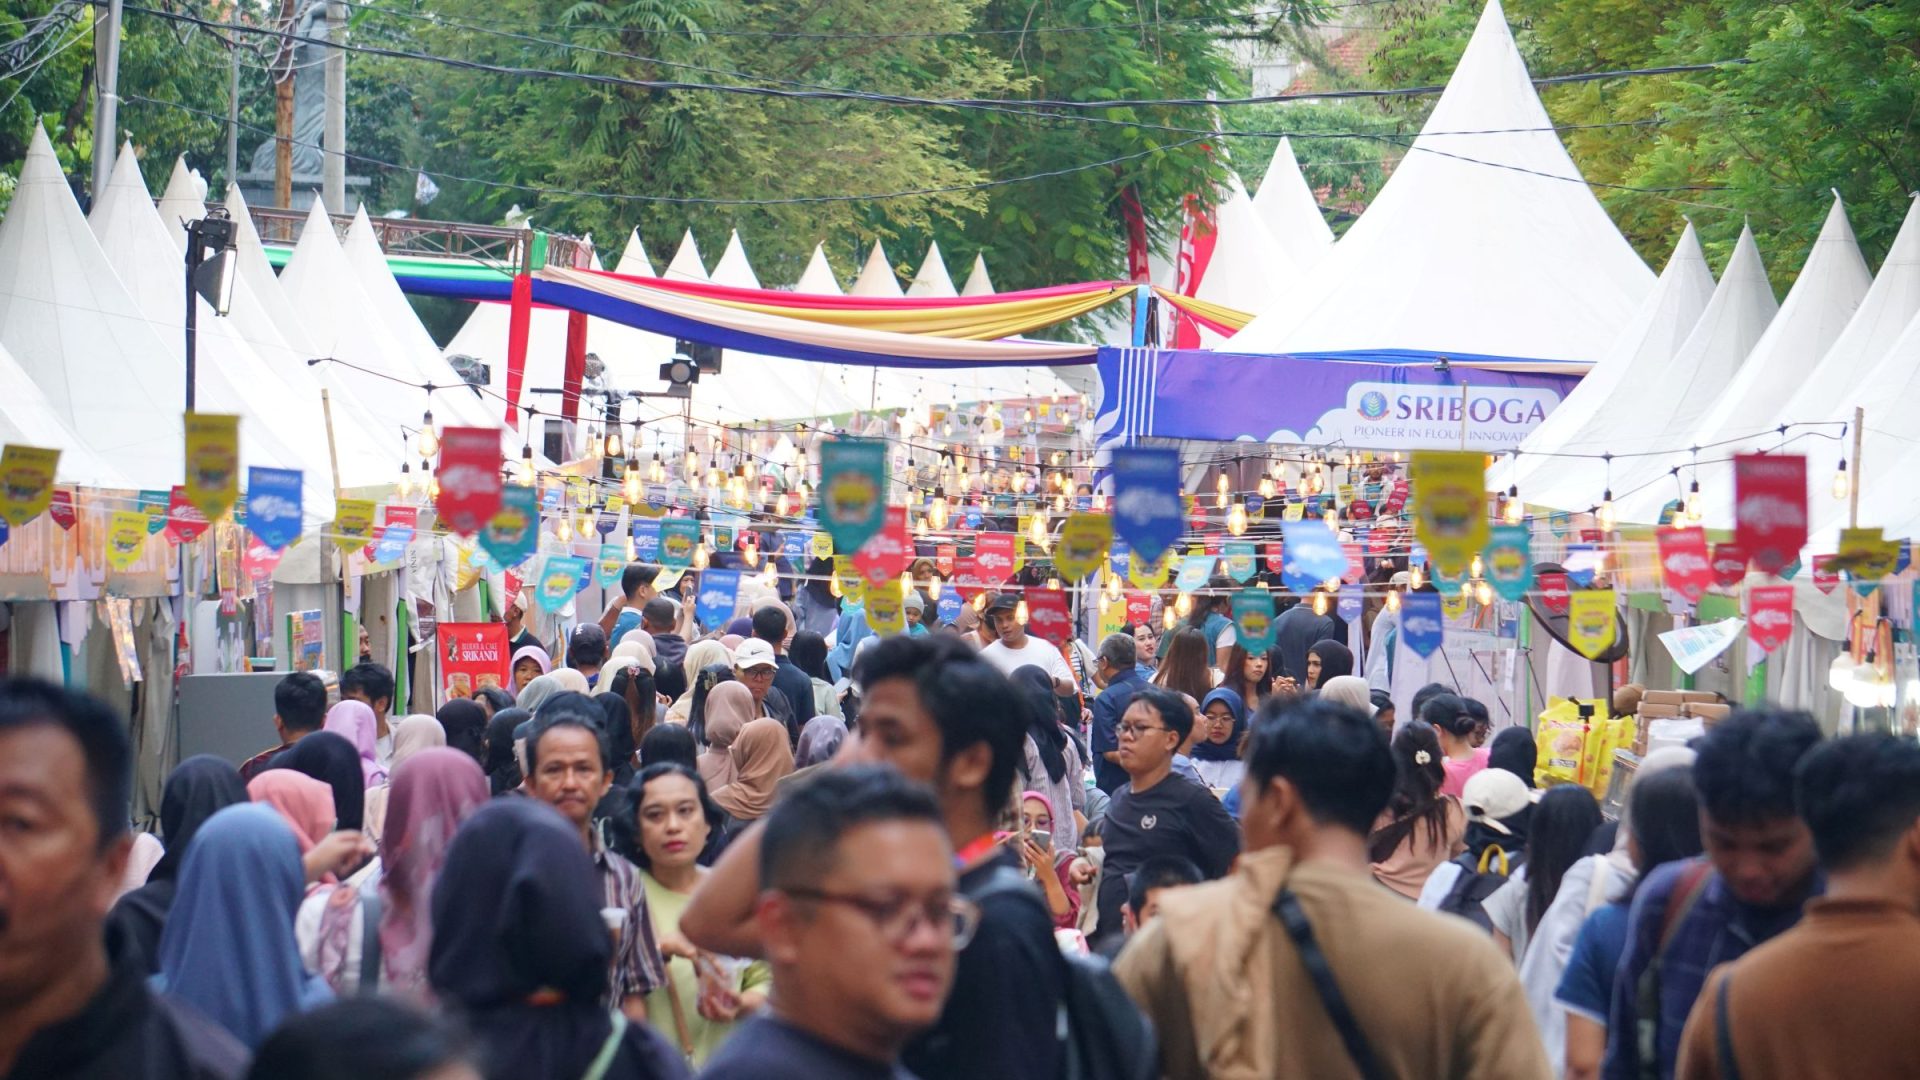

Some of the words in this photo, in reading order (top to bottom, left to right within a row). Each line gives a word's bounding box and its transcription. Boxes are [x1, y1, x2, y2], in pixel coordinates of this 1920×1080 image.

[1396, 394, 1546, 424] SRIBOGA
[1354, 425, 1404, 438] PIONEER
[1408, 428, 1421, 438] IN
[462, 650, 498, 661] SRIKANDI
